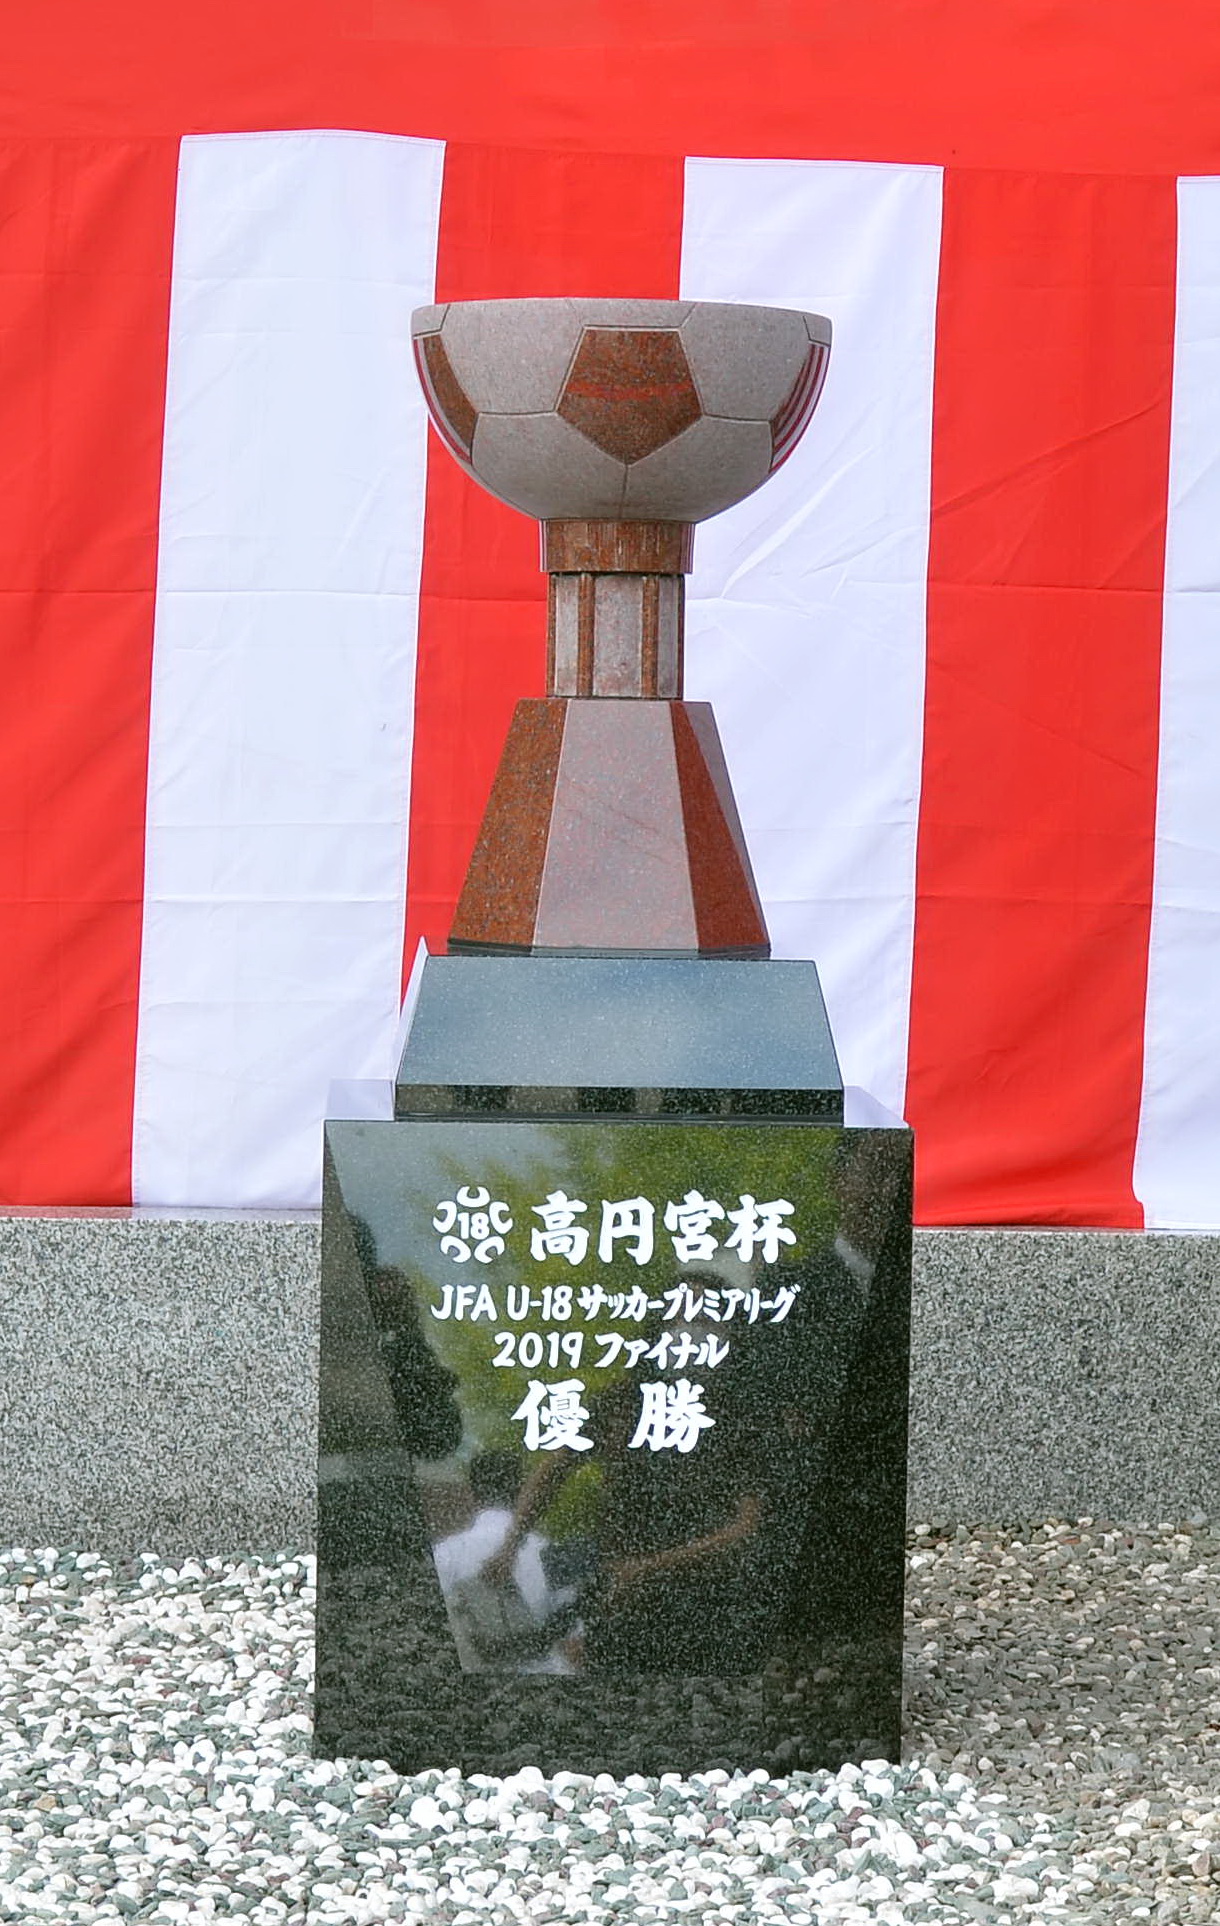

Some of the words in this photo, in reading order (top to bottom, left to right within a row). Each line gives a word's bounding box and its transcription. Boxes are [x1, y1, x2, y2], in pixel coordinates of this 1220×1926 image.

[457, 1212, 490, 1240] 18
[531, 1189, 797, 1265] 高円宮杯
[431, 1283, 497, 1321] JFA
[493, 1331, 583, 1369] 2019
[595, 1332, 730, 1369] ファイナル
